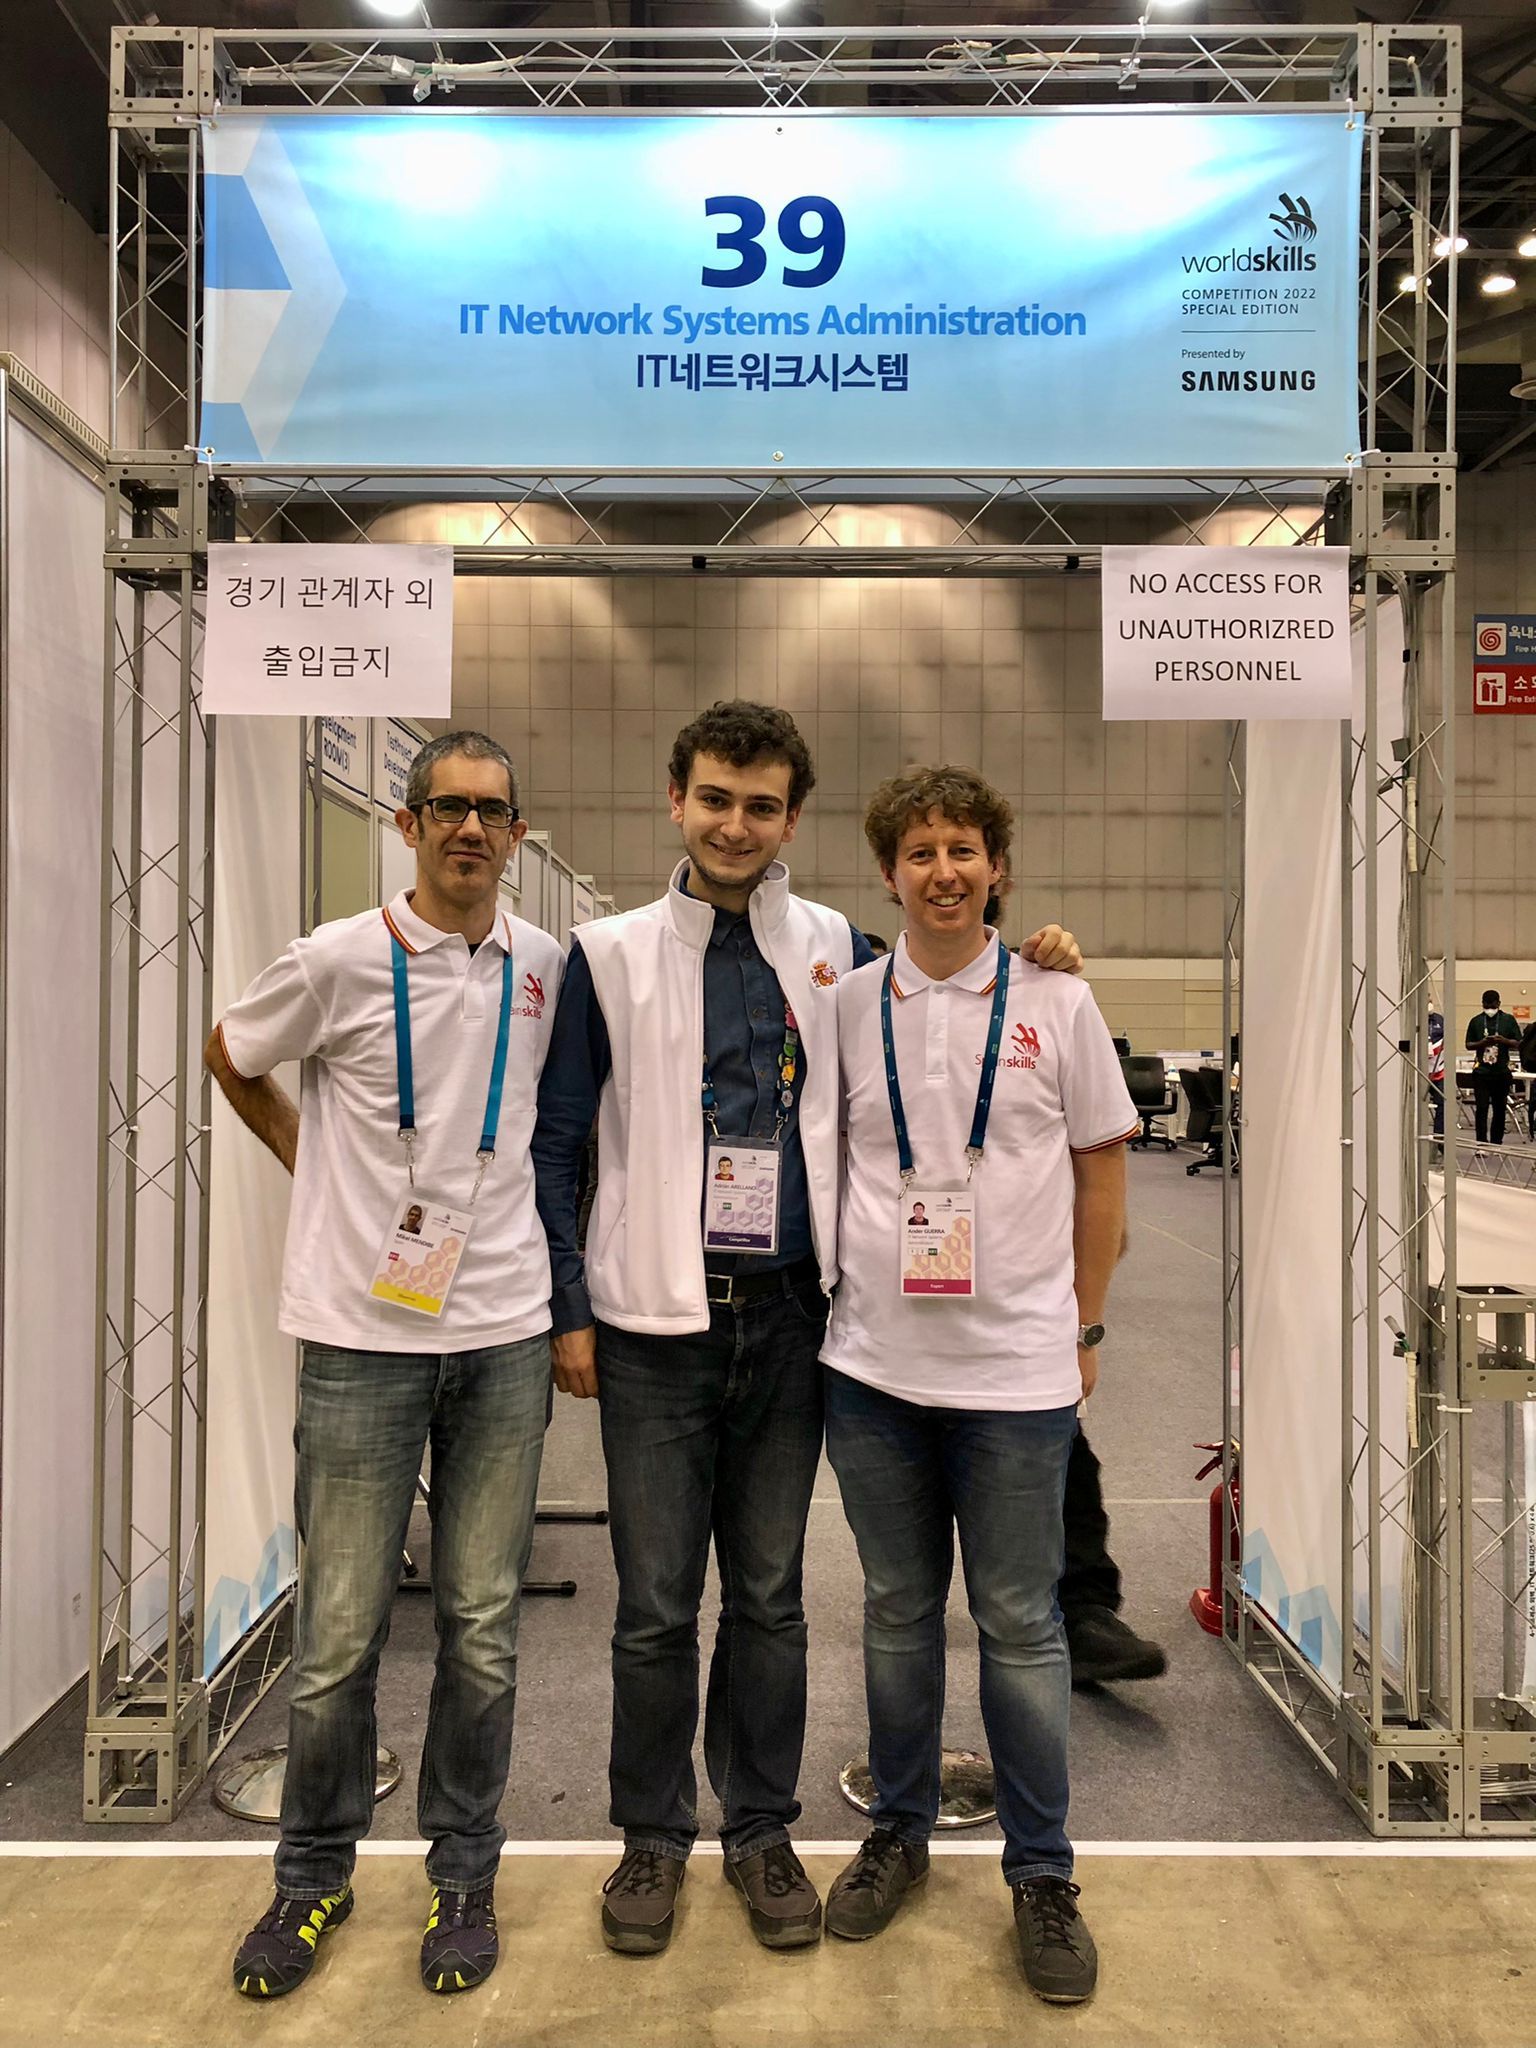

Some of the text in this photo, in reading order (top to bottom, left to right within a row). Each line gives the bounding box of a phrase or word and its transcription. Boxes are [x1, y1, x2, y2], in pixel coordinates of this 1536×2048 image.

[701, 195, 846, 288] 39
[1182, 246, 1317, 274] worldskills
[1182, 288, 1316, 300] COMPETITION 2022
[1182, 304, 1299, 315] SPECIAL EDITION
[459, 303, 1087, 344] IT Network Systems Administration
[1181, 349, 1246, 360] Presented by
[636, 352, 909, 392] IT네트워크시스템
[1181, 370, 1317, 392] SAMSUNG
[226, 576, 433, 609] 경기 관계자 외
[1129, 573, 1322, 594] NO ACCESS FOR
[1119, 619, 1334, 640] UNAUTHORIZRED
[262, 645, 389, 678] 출입금지
[1155, 661, 1302, 681] PERSONNEL
